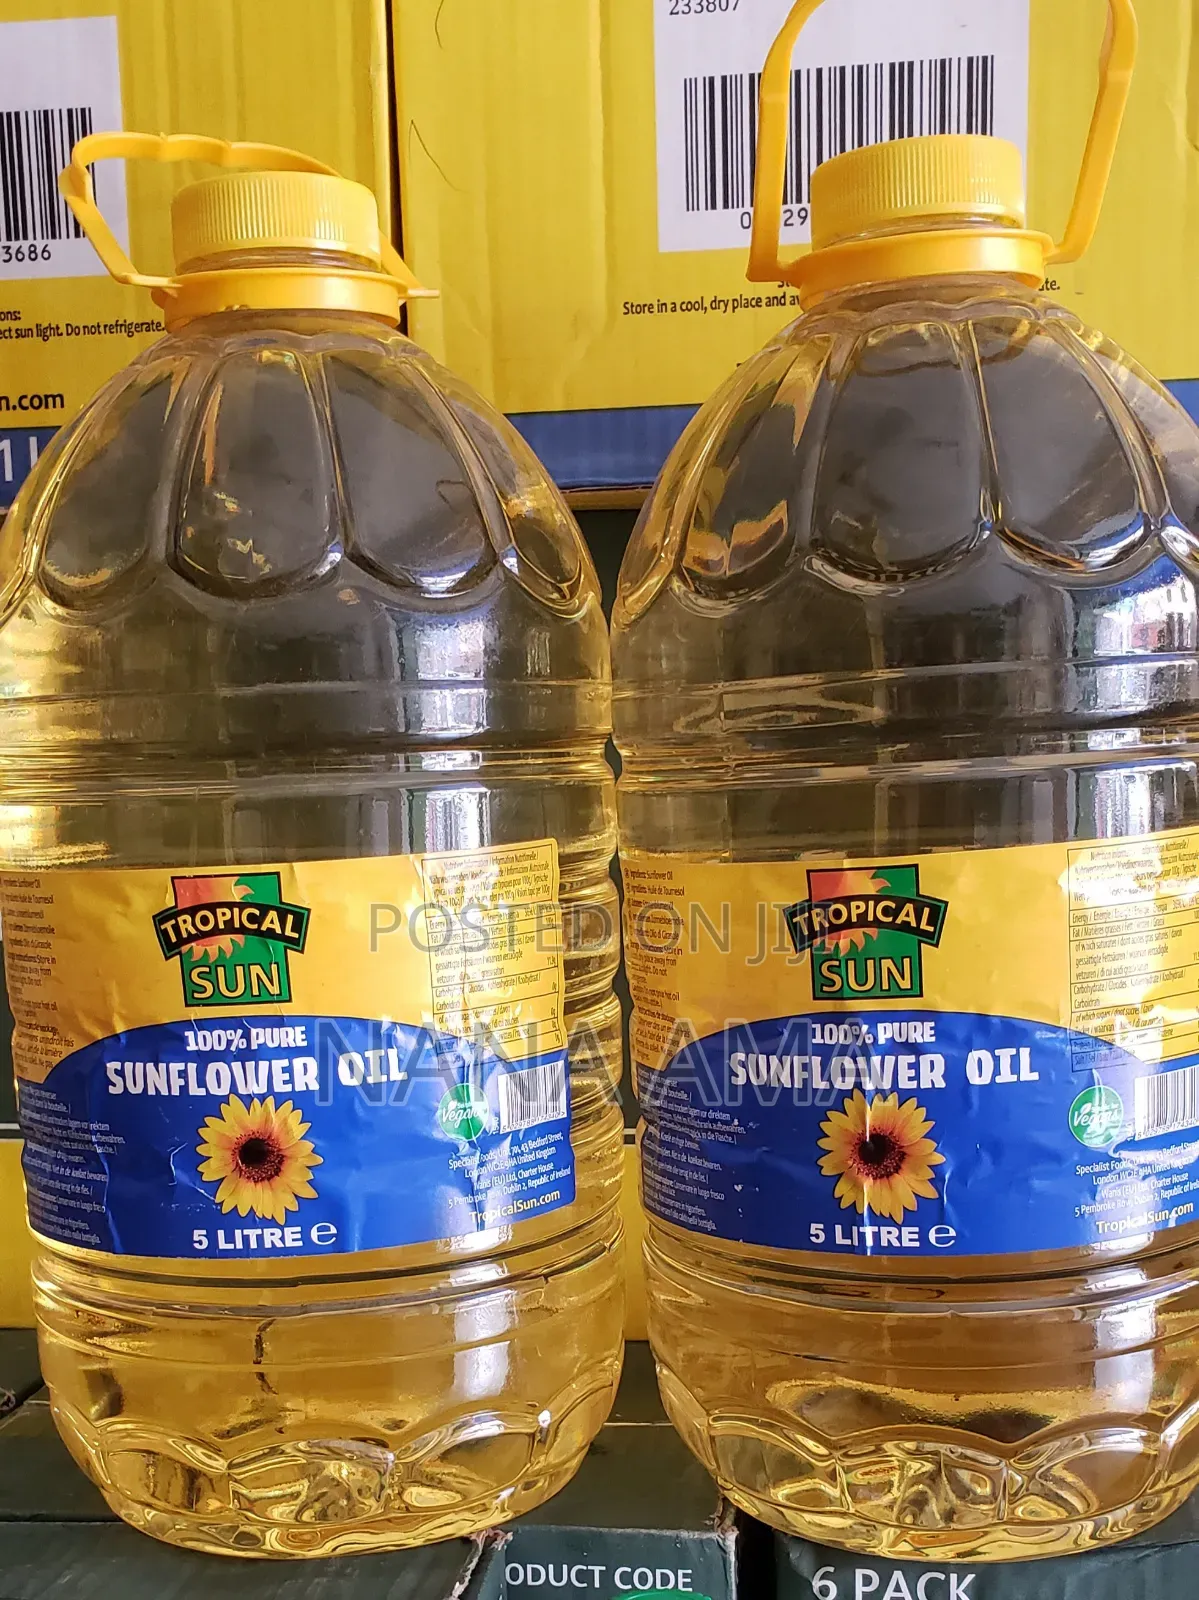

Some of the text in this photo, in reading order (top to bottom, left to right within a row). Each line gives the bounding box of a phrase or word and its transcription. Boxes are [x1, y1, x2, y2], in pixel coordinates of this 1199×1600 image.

[669, 0, 740, 15] 233807
[2, 243, 51, 263] 3686
[623, 301, 654, 315] Store
[656, 299, 667, 313] in
[670, 303, 676, 312] a
[680, 296, 708, 314] cool,
[710, 296, 729, 313] dry
[732, 294, 763, 312] place
[765, 292, 786, 307] and
[15, 327, 33, 339] sun
[36, 323, 63, 342] light.
[66, 323, 80, 336] Do
[83, 322, 101, 335] not
[104, 319, 165, 337] refrigerate.
[160, 907, 299, 944] TROPICAL
[793, 900, 935, 936] TROPICAL
[190, 963, 281, 999] SUN
[820, 957, 911, 993] SUN
[184, 1026, 308, 1053] 100% PURE
[812, 1021, 937, 1046] 100% PURE
[106, 1048, 408, 1097] SUNFLOWER OIL
[730, 1047, 1040, 1091] SUNFLOWER OIL
[1075, 1162, 1110, 1176] Specialist
[1093, 1171, 1119, 1186] London
[1172, 1172, 1189, 1184] House
[468, 1190, 561, 1221] TropicalSun.com
[1074, 1206, 1080, 1218] 5
[1095, 1202, 1194, 1234] TropicalSun.com
[193, 1229, 209, 1250] 5
[217, 1226, 304, 1250] LITRE
[809, 1223, 826, 1244] 5
[834, 1224, 920, 1248] LITRE
[613, 1566, 693, 1592] CODE
[812, 1566, 976, 1600] 6 PACK
